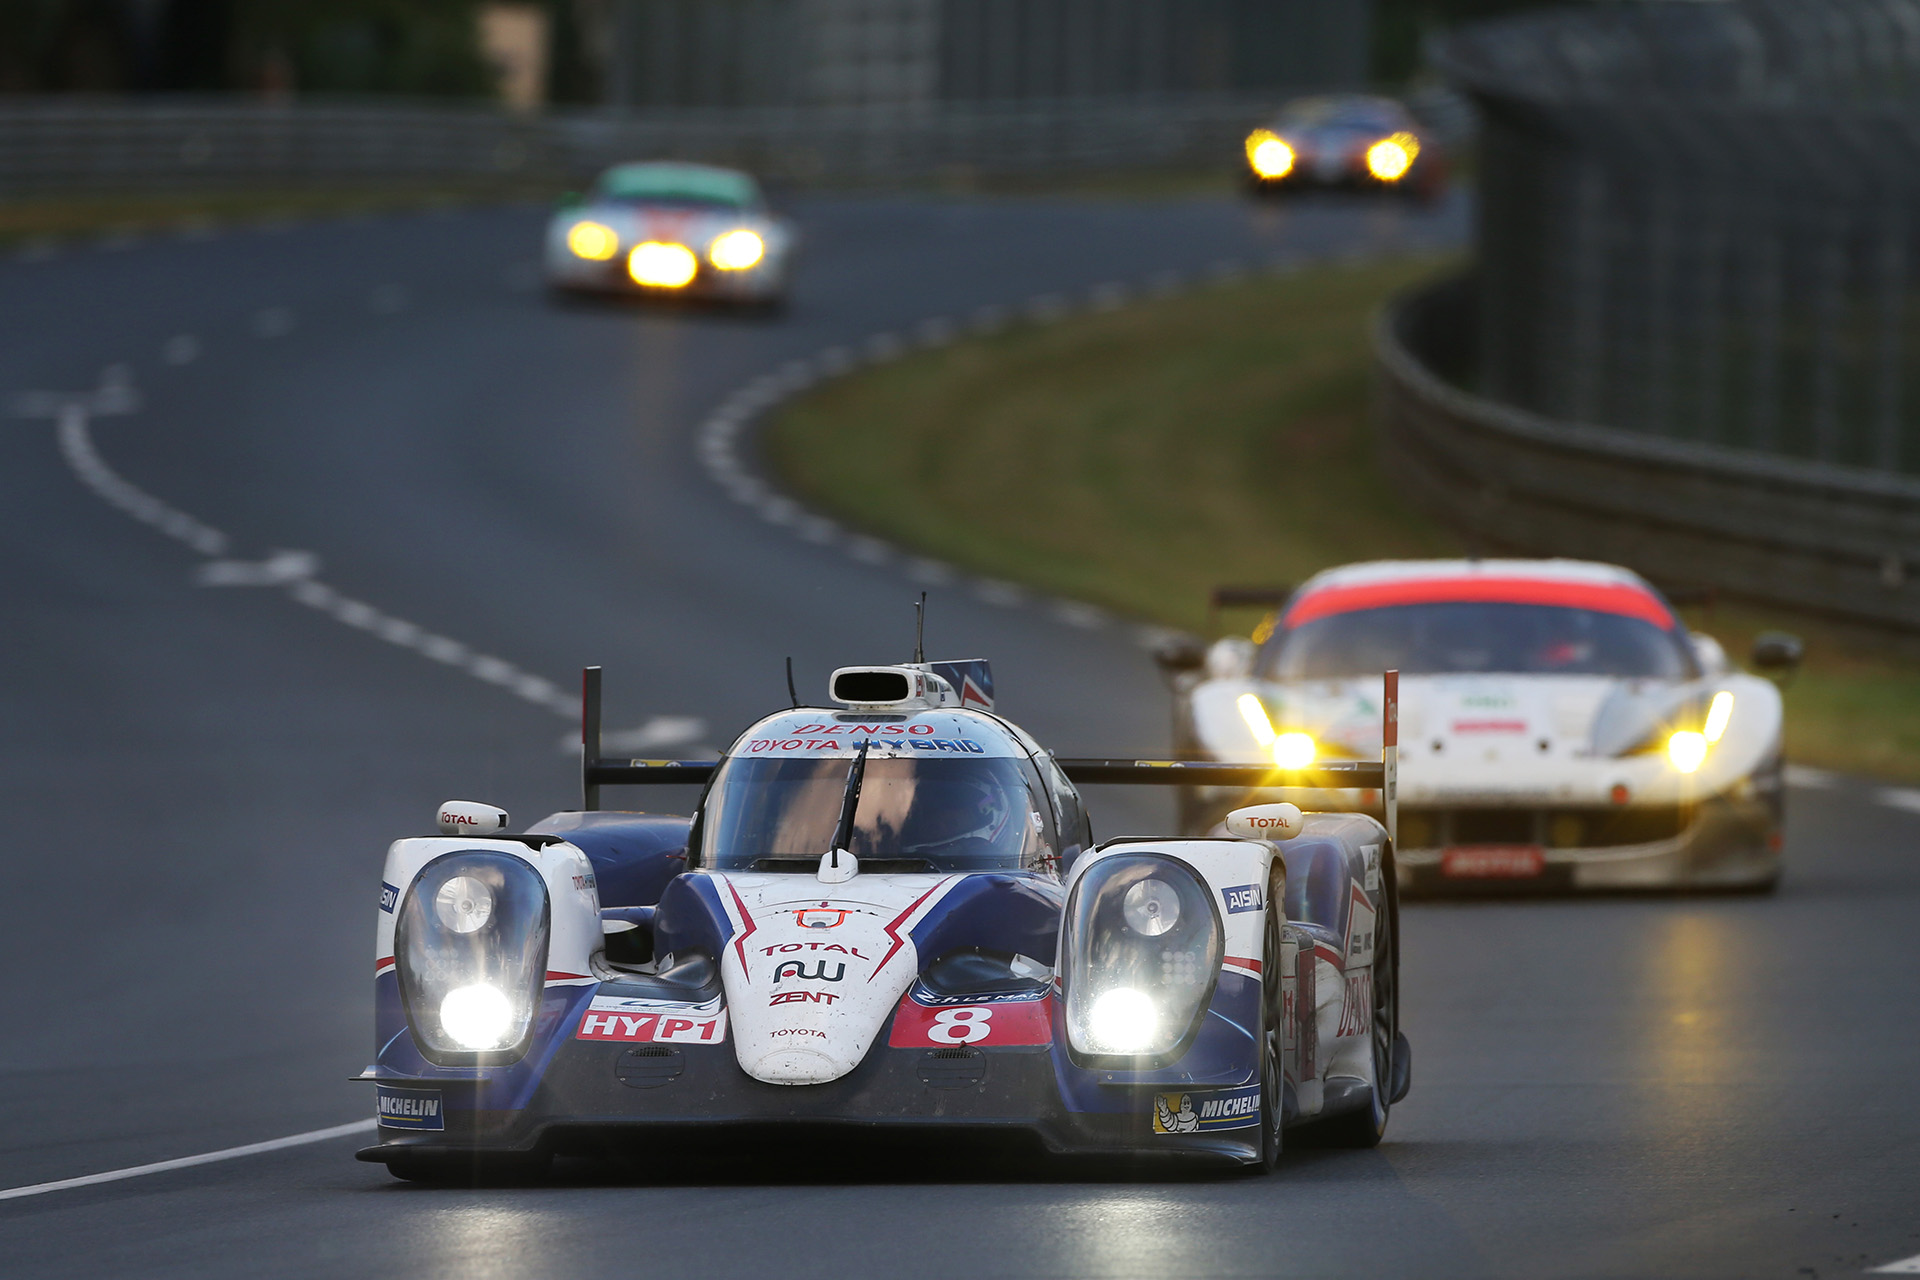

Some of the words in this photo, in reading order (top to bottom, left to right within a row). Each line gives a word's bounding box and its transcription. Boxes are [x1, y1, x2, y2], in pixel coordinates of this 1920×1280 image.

[791, 724, 935, 736] DENSO
[743, 739, 840, 754] TOYOTA
[852, 738, 986, 755] HYBRID
[441, 811, 479, 826] TOTAL
[1245, 816, 1290, 829] TOTAL
[1229, 888, 1262, 910] AISIN
[759, 942, 870, 961] TOTAL
[768, 990, 841, 1007] ZENT
[581, 1014, 654, 1037] HY
[660, 1018, 718, 1041] P1
[769, 1028, 828, 1040] TOYOTA
[927, 1007, 994, 1045] 8
[380, 1095, 439, 1117] MICHELIN
